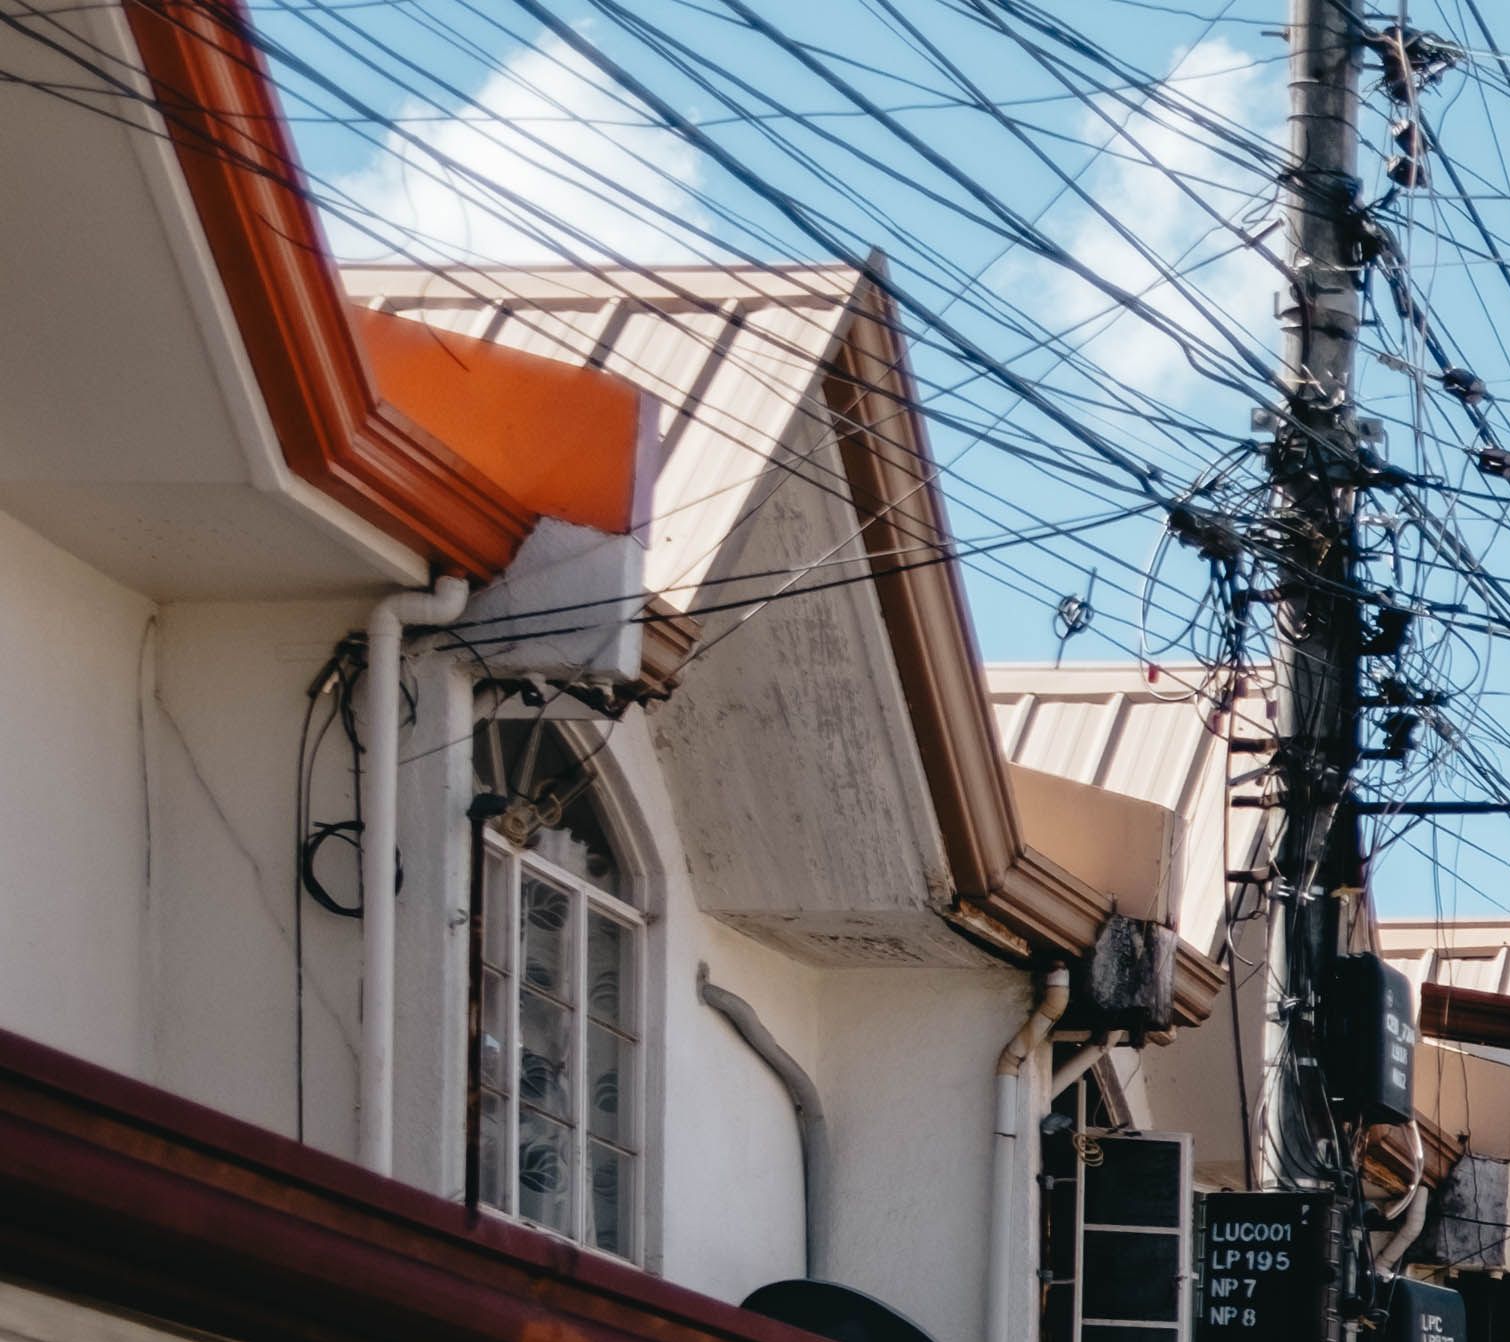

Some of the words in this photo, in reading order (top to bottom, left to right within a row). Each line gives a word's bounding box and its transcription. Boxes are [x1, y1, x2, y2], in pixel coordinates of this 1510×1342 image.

[1213, 1250, 1240, 1269] LP
[1246, 1250, 1290, 1271] 195
[1212, 1278, 1239, 1297] NP
[1243, 1279, 1257, 1298] 7
[1211, 1306, 1238, 1326] NP
[1242, 1308, 1256, 1326] 8
